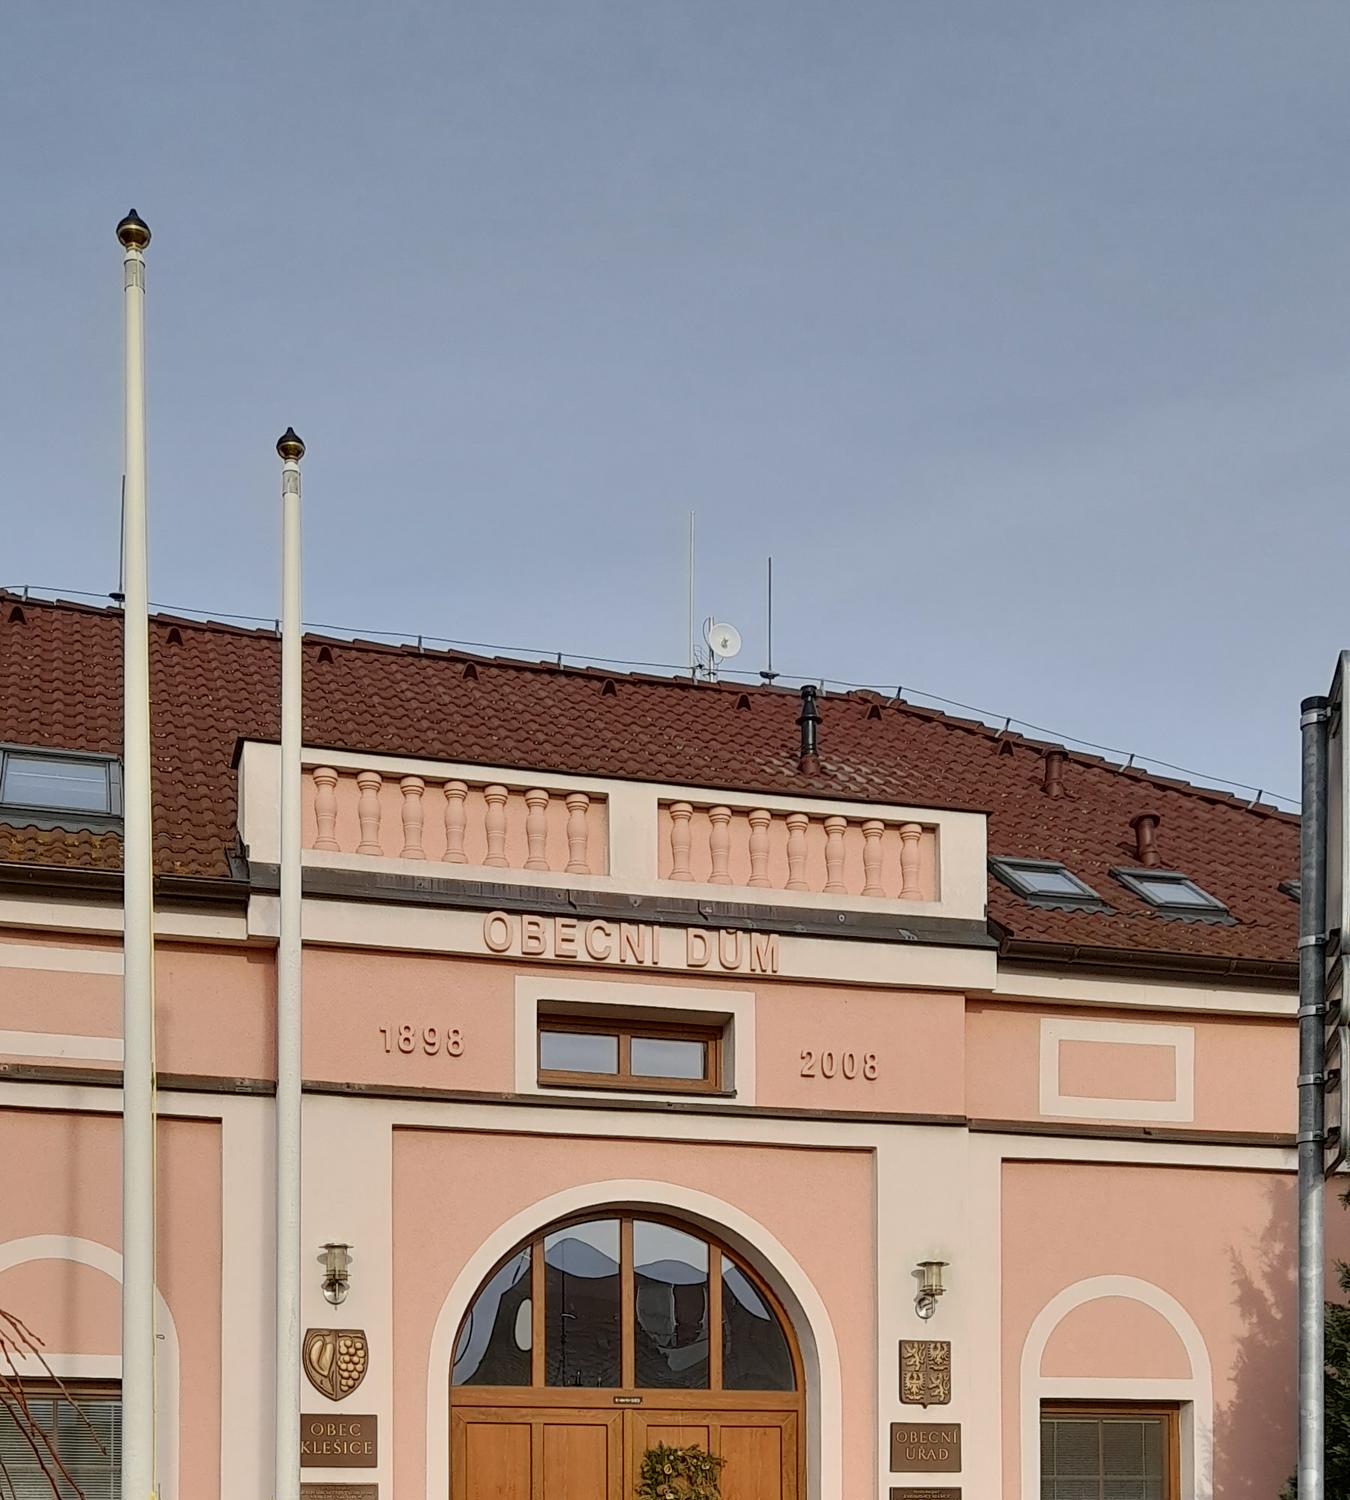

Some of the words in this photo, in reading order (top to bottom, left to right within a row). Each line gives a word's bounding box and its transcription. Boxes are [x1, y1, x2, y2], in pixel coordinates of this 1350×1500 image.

[379, 1024, 464, 1057] 1898
[800, 1048, 880, 1081] 2008
[310, 1422, 361, 1436] OBEC
[896, 1428, 958, 1443] OBECNÍ
[301, 1439, 373, 1455] KLEŠICE
[906, 1445, 949, 1460] ÚŘAD
